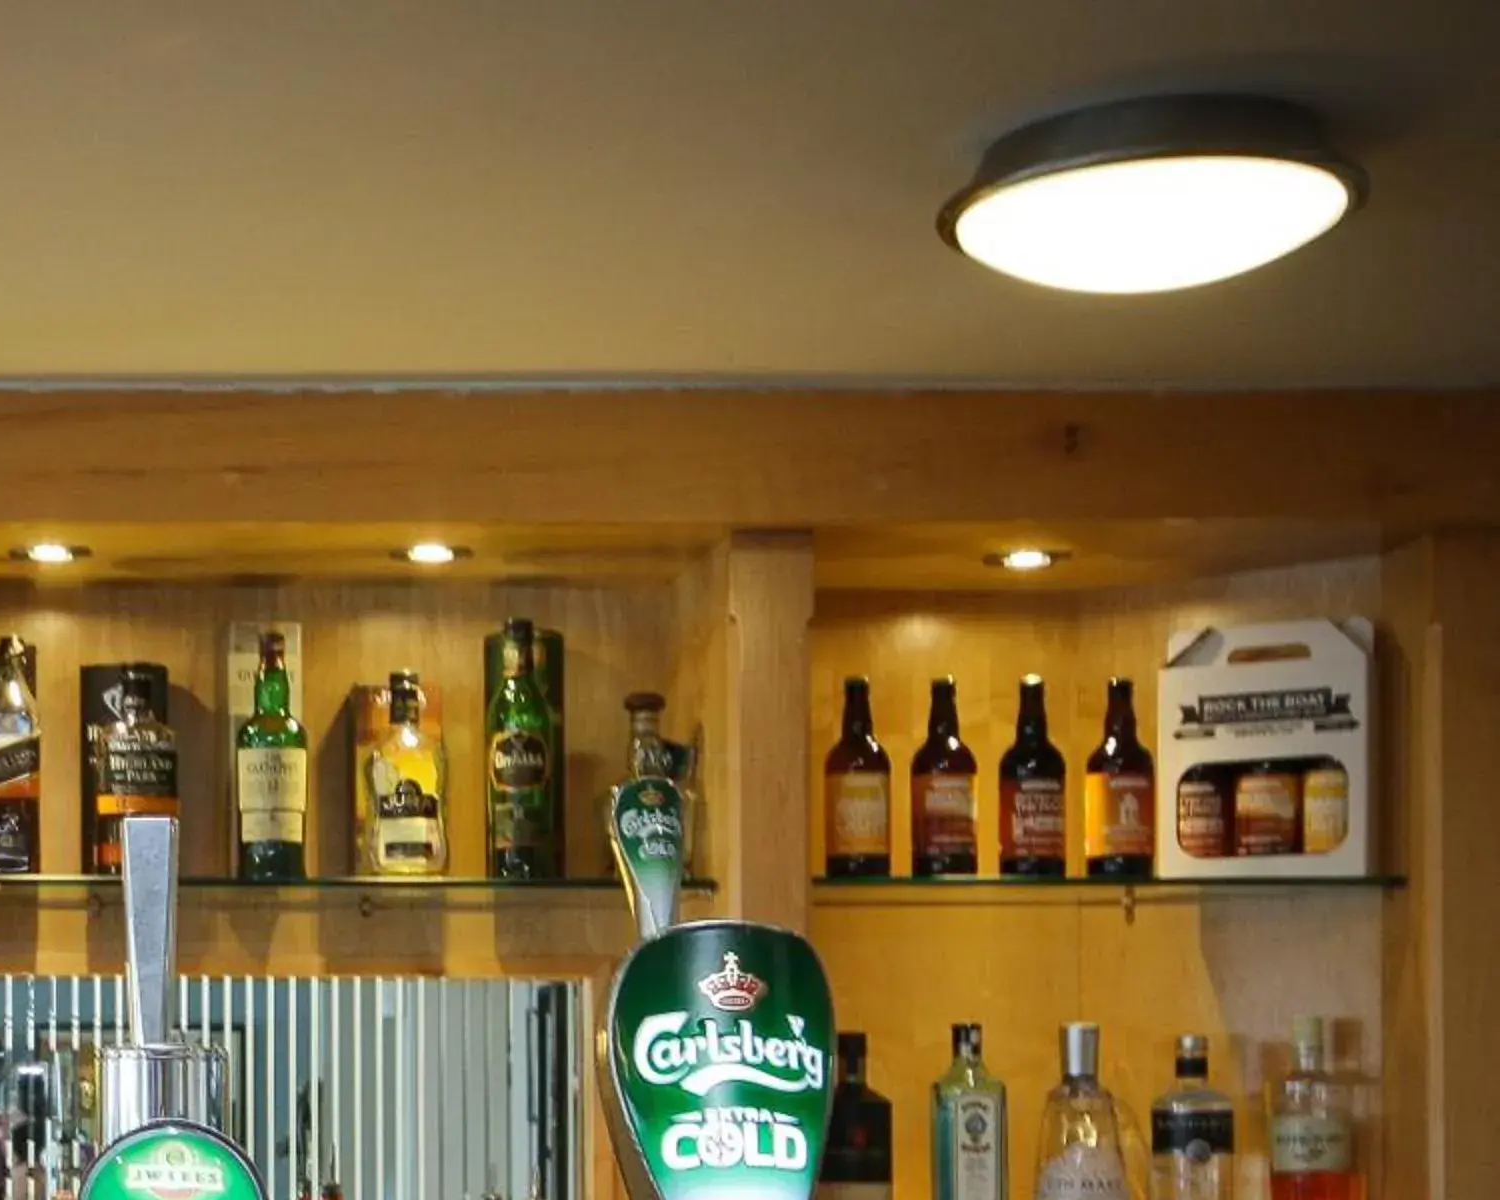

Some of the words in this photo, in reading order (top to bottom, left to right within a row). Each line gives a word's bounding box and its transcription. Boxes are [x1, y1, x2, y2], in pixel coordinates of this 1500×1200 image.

[109, 754, 174, 771] HIGHLAND
[126, 768, 157, 781] PARK
[633, 1010, 824, 1097] Carlsberg
[660, 1120, 808, 1170] COLD
